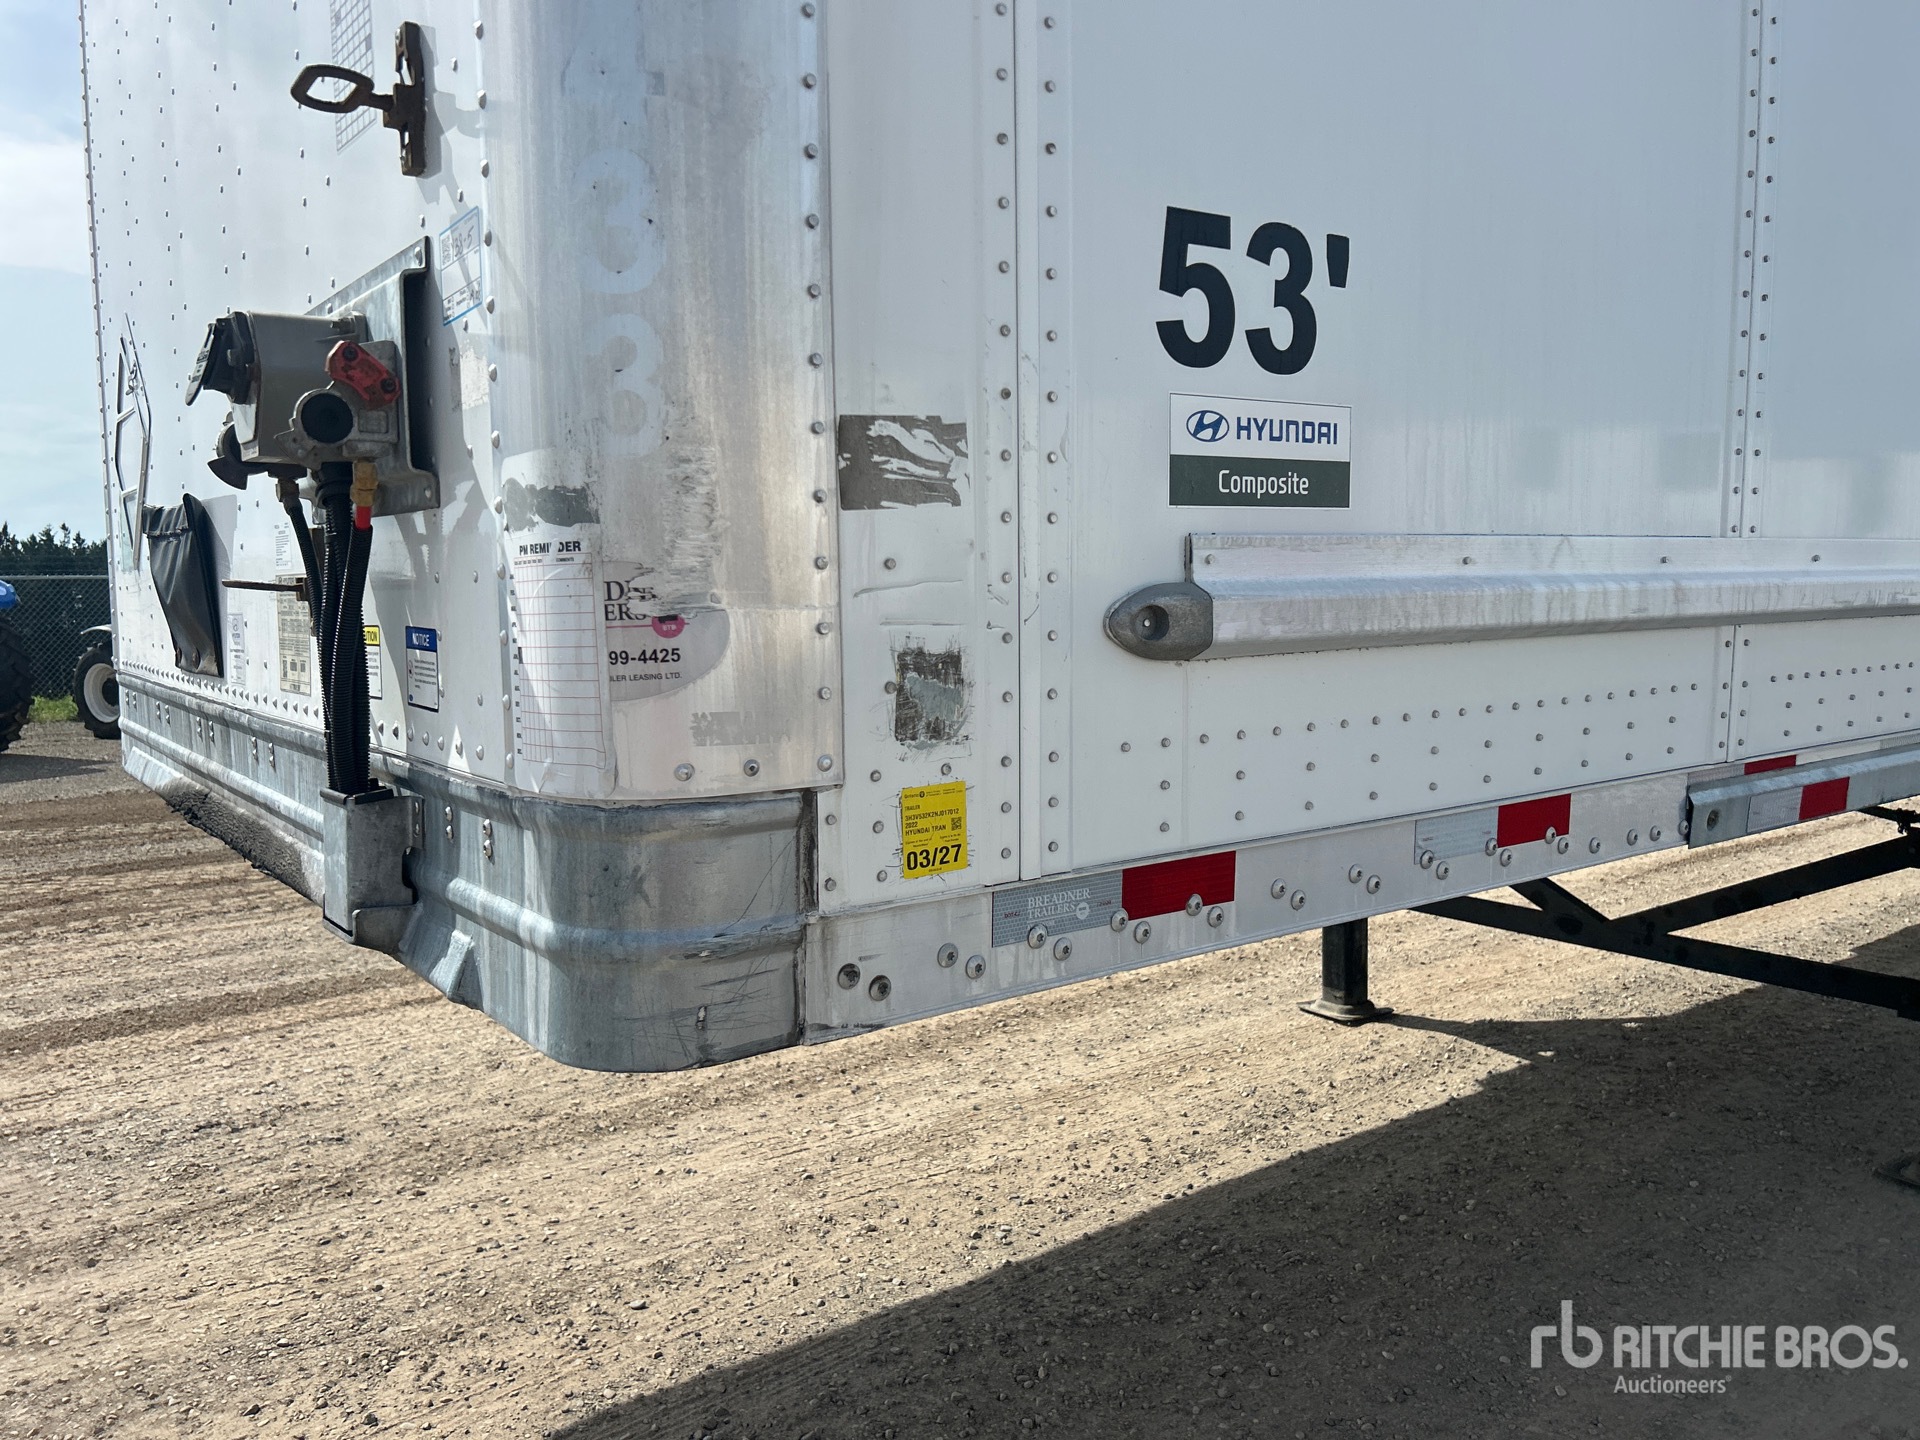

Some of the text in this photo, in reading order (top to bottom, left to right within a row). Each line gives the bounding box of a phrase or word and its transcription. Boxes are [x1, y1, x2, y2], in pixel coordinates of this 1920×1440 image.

[1156, 205, 1350, 375] 53'
[1236, 416, 1338, 445] HYUNDAI
[1218, 469, 1310, 499] Composite
[530, 540, 582, 555] REMIDER
[412, 632, 430, 647] NOTICE
[629, 672, 663, 681] LEASING
[665, 671, 682, 680] LTD.
[905, 821, 918, 829] 2022
[905, 824, 947, 836] HYUNDAI TRAN
[906, 843, 962, 871] 03/27
[1027, 888, 1091, 909] BREADNER
[1027, 902, 1076, 919] TRAILERS
